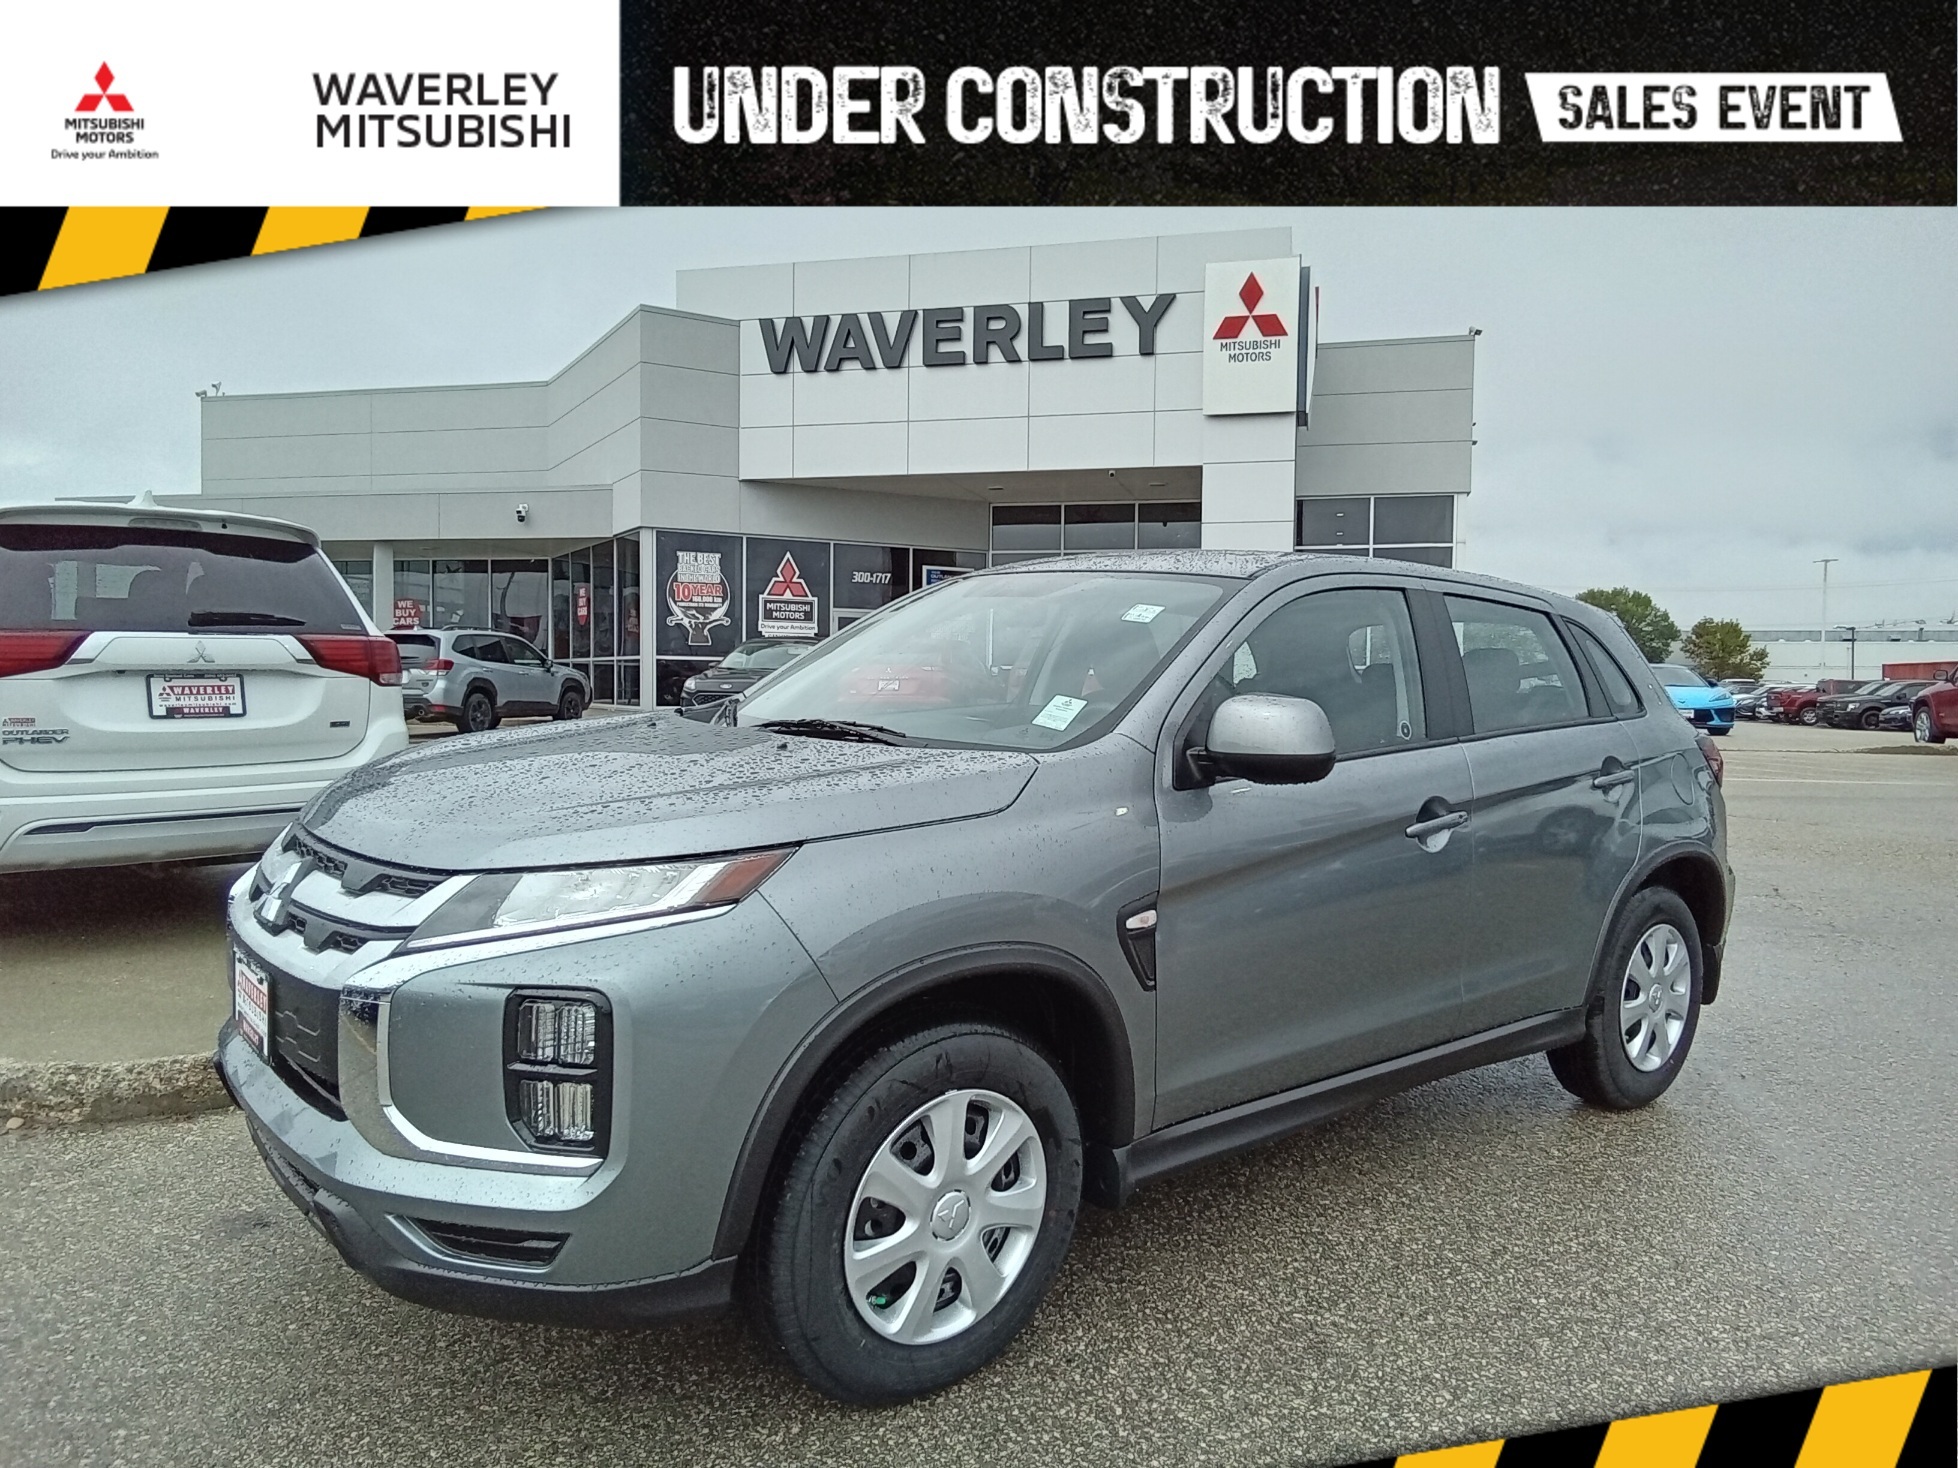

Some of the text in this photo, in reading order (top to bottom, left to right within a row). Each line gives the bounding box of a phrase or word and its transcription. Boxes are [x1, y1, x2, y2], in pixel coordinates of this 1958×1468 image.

[758, 293, 1177, 375] WAVERLEY
[1220, 339, 1281, 352] MITSUBISHI
[1228, 351, 1272, 363] MOTORS
[676, 551, 722, 565] THE BEST
[851, 571, 892, 584] 300-1717
[673, 582, 723, 601] 10 YEAR
[397, 600, 413, 608] WE
[766, 602, 811, 612] MITSUBISHI
[395, 609, 416, 617] BUY
[772, 611, 805, 620] MOTORS
[393, 617, 420, 626] CARS
[172, 685, 234, 695] WAVERLEY
[2, 736, 70, 745] PHEV
